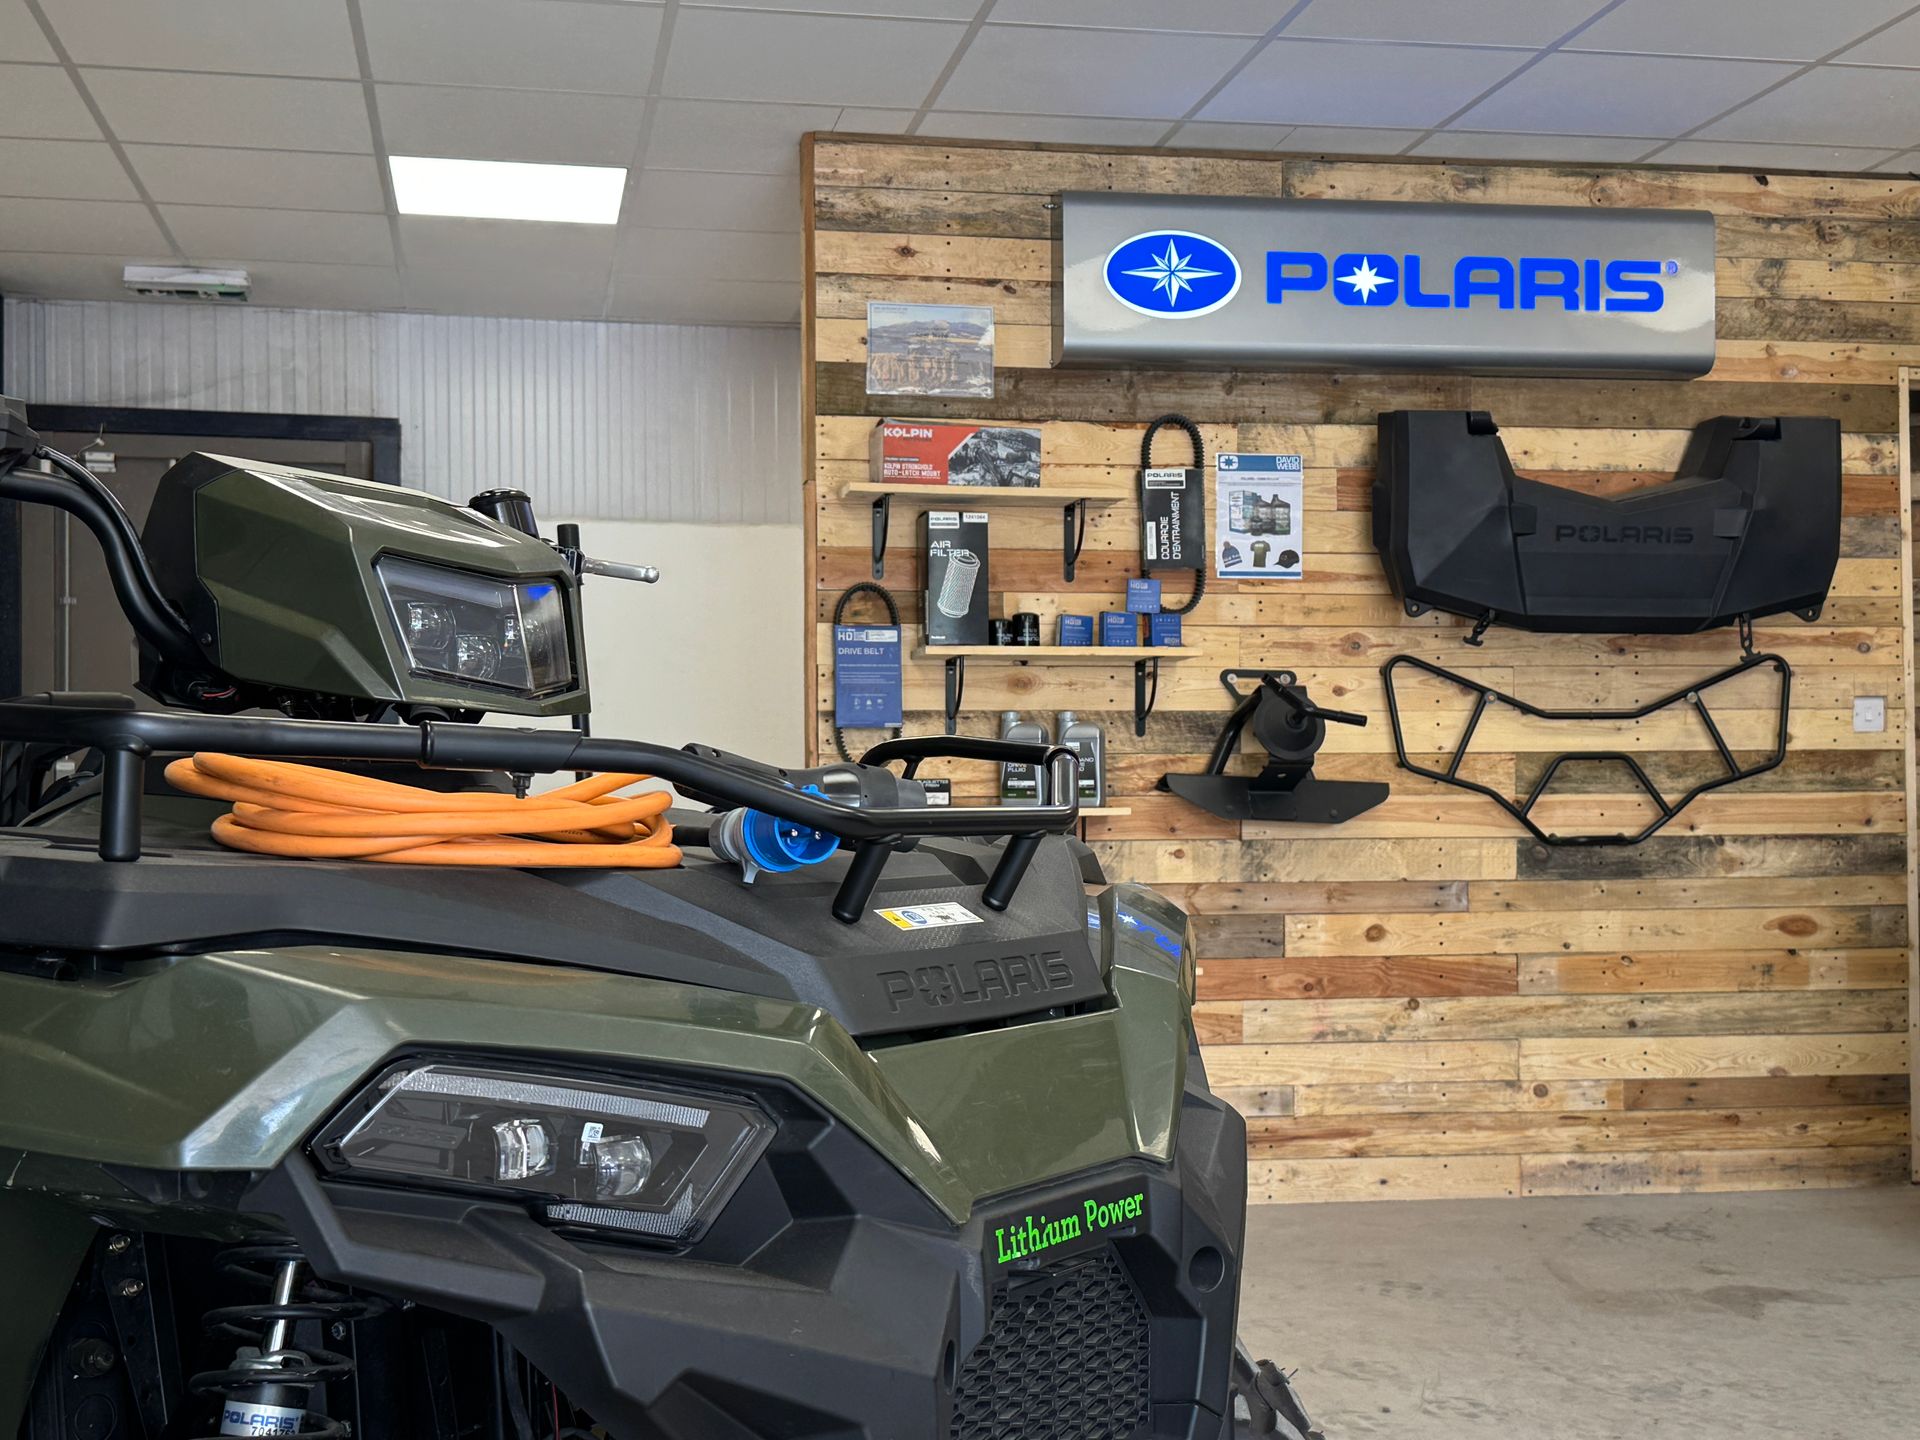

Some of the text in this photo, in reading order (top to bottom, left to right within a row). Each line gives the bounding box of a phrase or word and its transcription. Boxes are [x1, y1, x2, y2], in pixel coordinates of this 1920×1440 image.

[1266, 250, 1665, 313] POLARIS
[883, 427, 933, 439] KOLPIN
[1277, 462, 1300, 470] WEBB
[1554, 525, 1695, 544] POLARIS
[930, 540, 952, 549] AIR
[930, 549, 970, 558] FILTER
[838, 631, 853, 641] HD
[838, 647, 885, 656] DRIVE BELT
[876, 950, 1075, 1014] POLARIS
[995, 1193, 1144, 1264] Lithium Power
